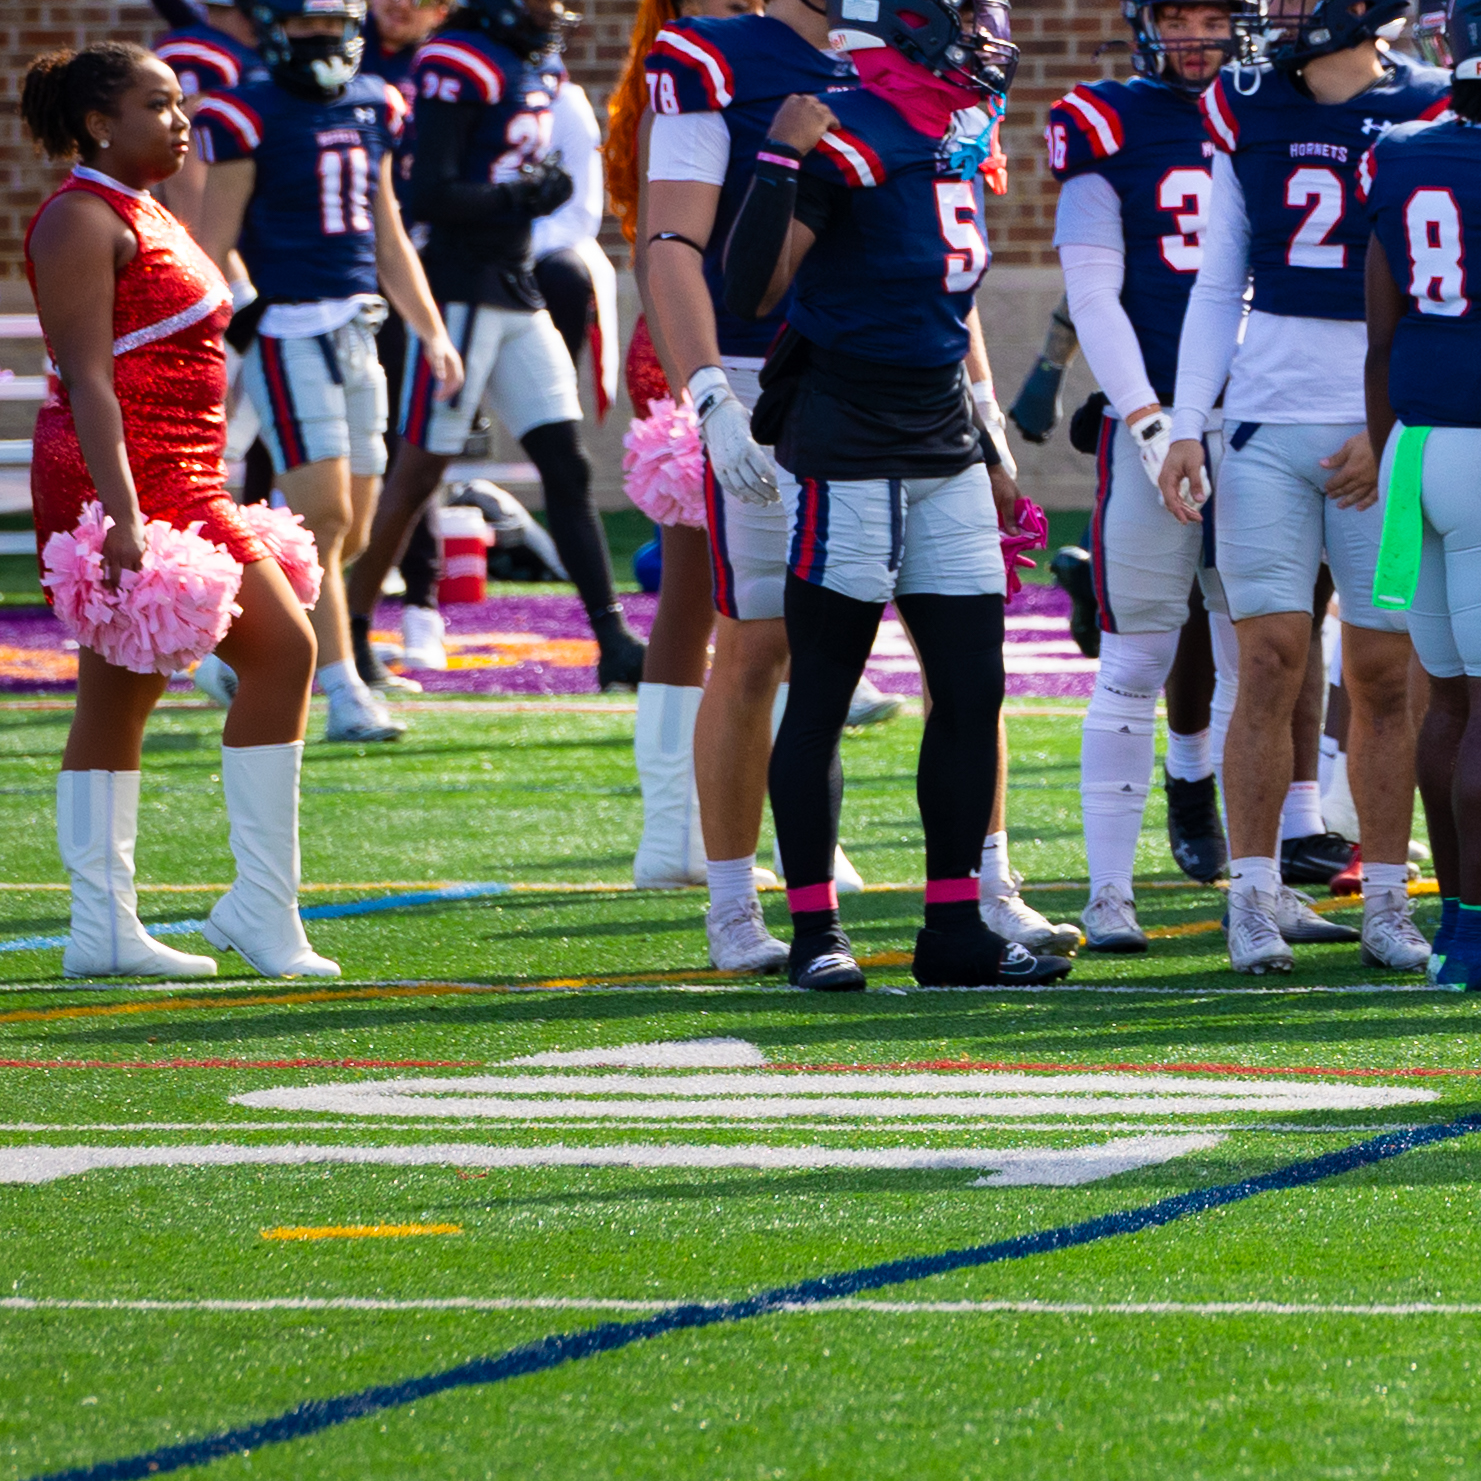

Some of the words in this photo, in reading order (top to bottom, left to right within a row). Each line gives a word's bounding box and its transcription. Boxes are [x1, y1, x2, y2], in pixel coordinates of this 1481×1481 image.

[644, 71, 681, 116] 78
[317, 146, 373, 235] 11
[1289, 141, 1349, 163] HORNETS
[932, 178, 989, 295] 5
[1284, 164, 1348, 270] 2
[1402, 185, 1472, 318] 8
